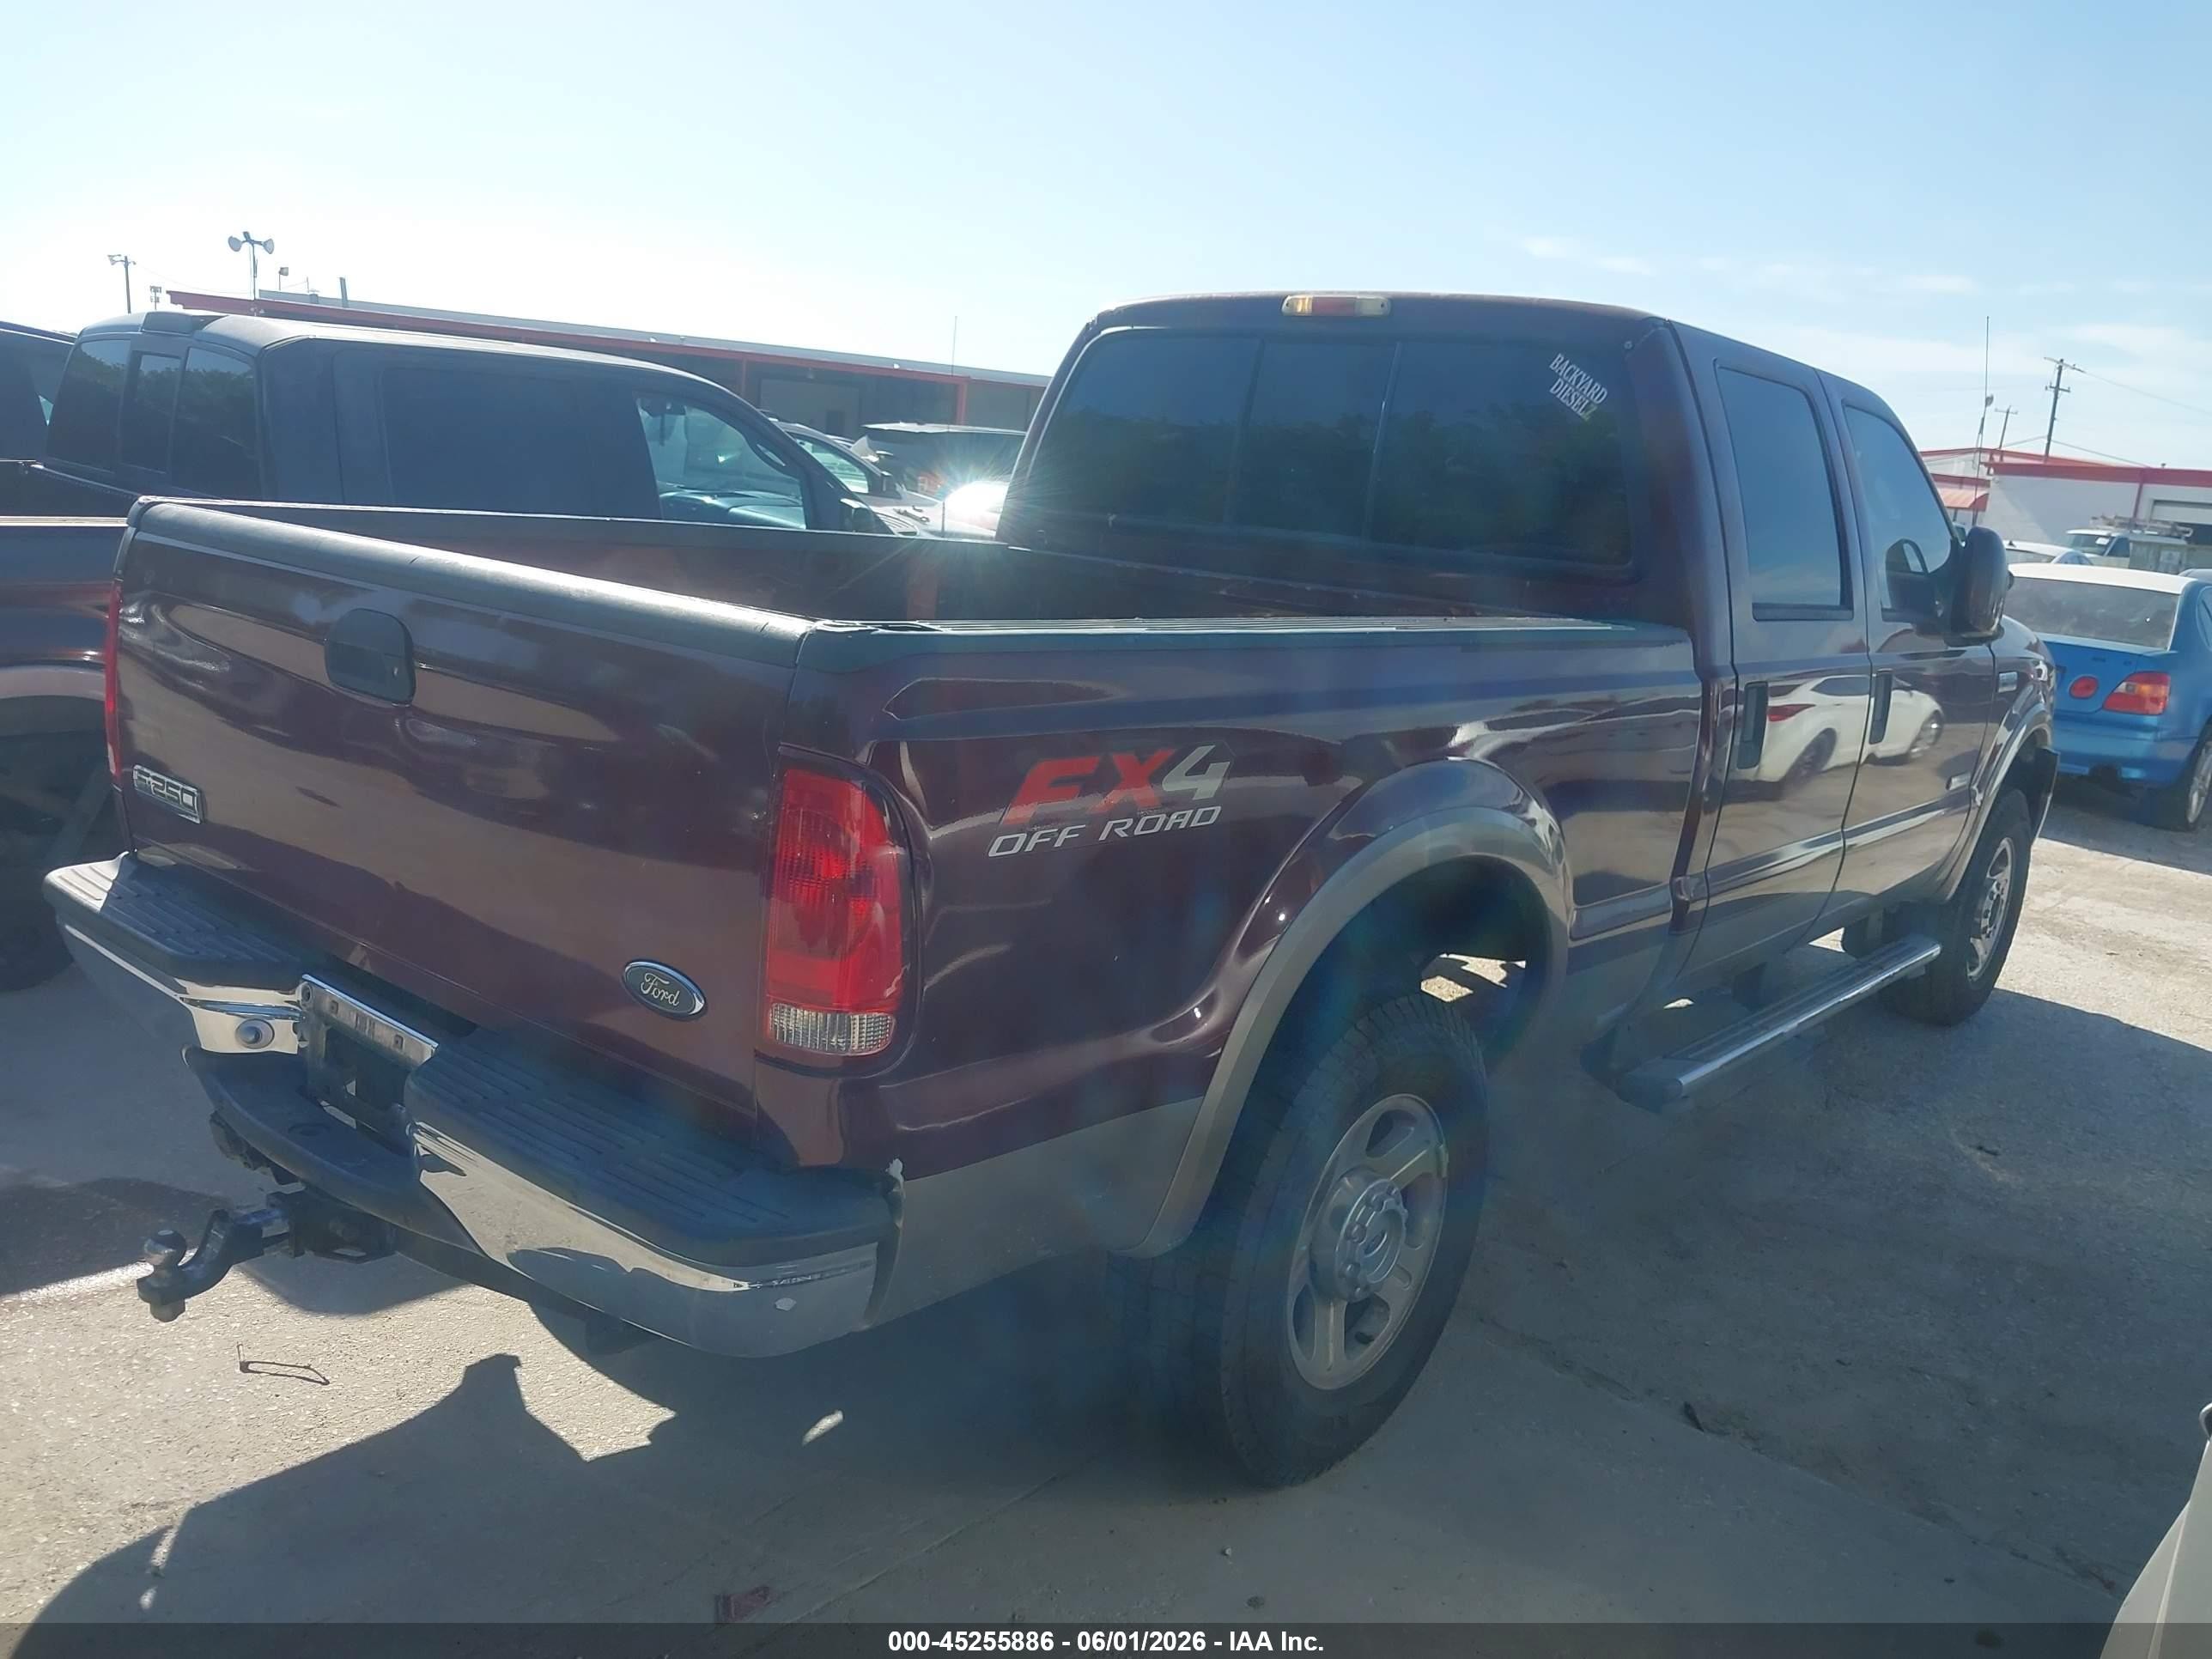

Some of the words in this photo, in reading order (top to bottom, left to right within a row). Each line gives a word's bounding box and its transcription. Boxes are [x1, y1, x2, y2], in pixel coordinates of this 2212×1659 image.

[1549, 353, 1608, 404] BACKYARD
[1001, 744, 1230, 825] FX4
[988, 823, 1086, 858] OFF
[1098, 805, 1222, 842] ROAD
[641, 972, 680, 1006] Ford
